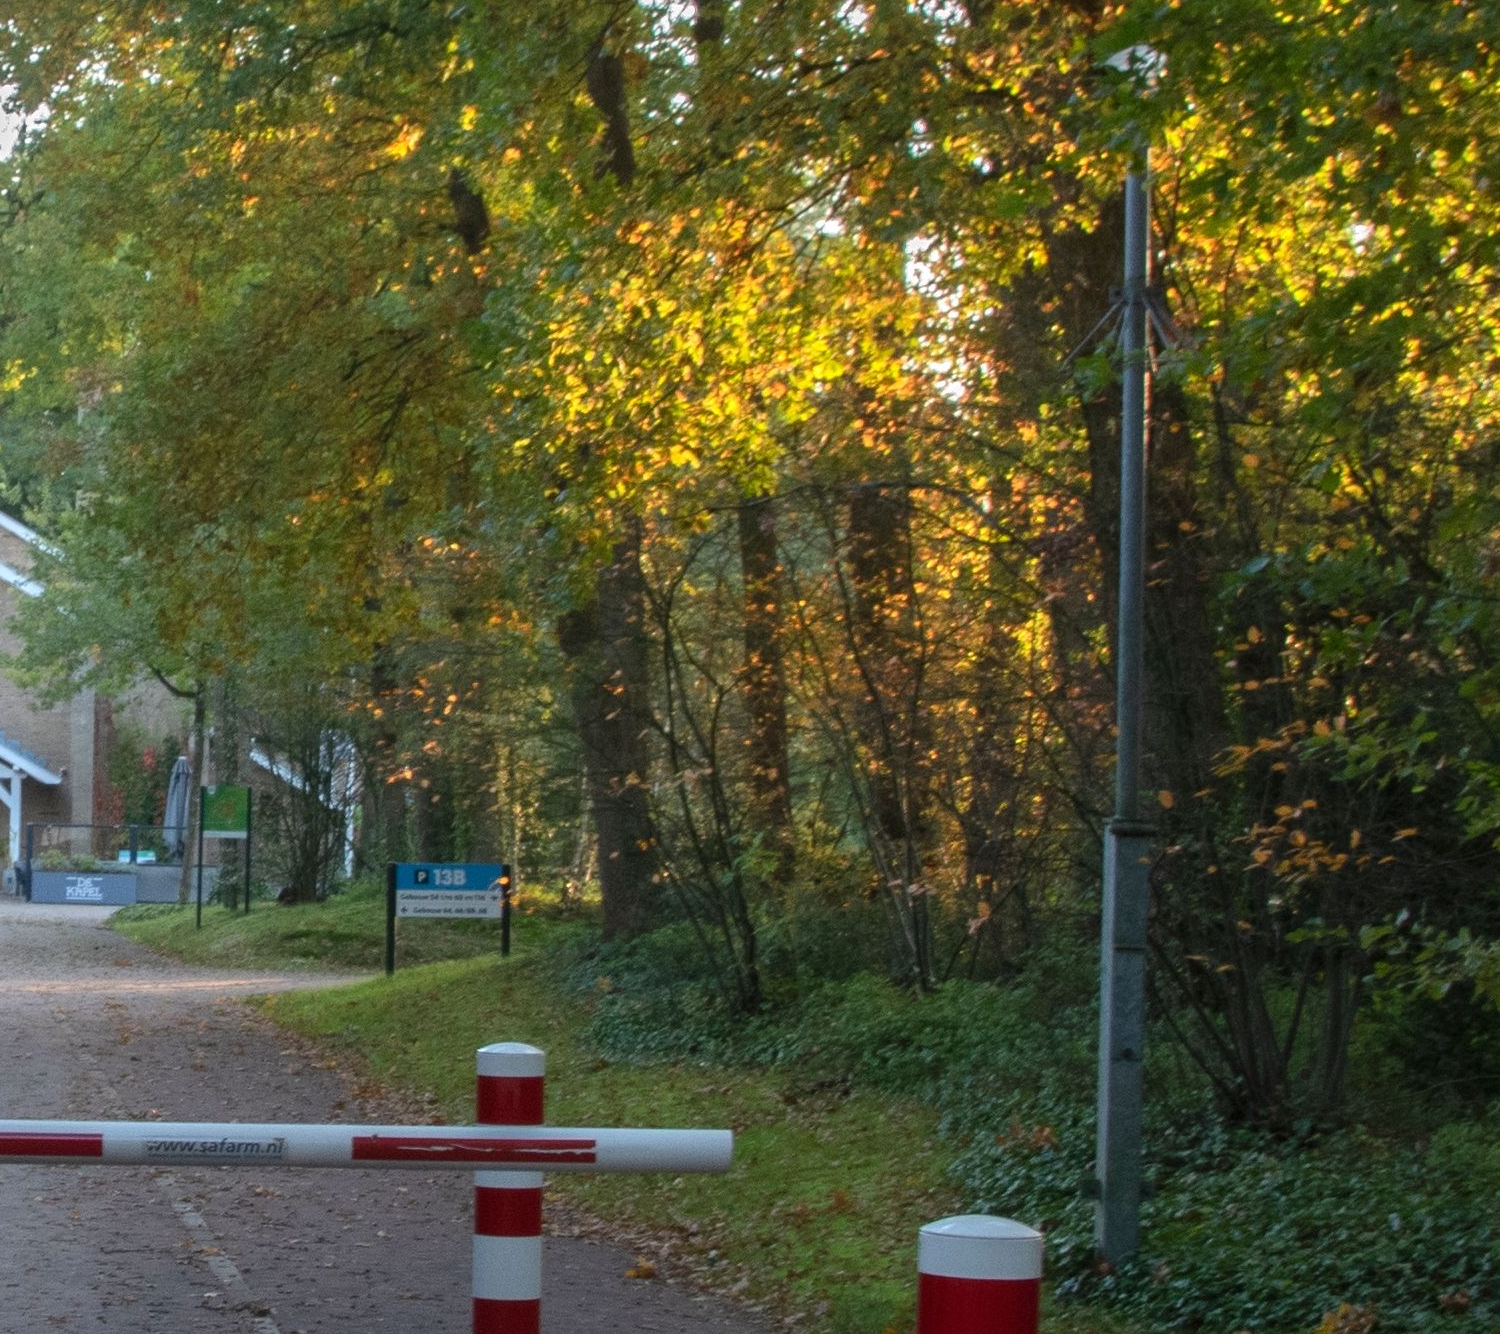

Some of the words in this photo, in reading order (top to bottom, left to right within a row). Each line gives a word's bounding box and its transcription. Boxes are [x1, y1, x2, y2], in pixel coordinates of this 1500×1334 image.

[77, 876, 93, 887] DE
[66, 886, 103, 896] KAPEL
[148, 1138, 283, 1154] www.safarm.nl
